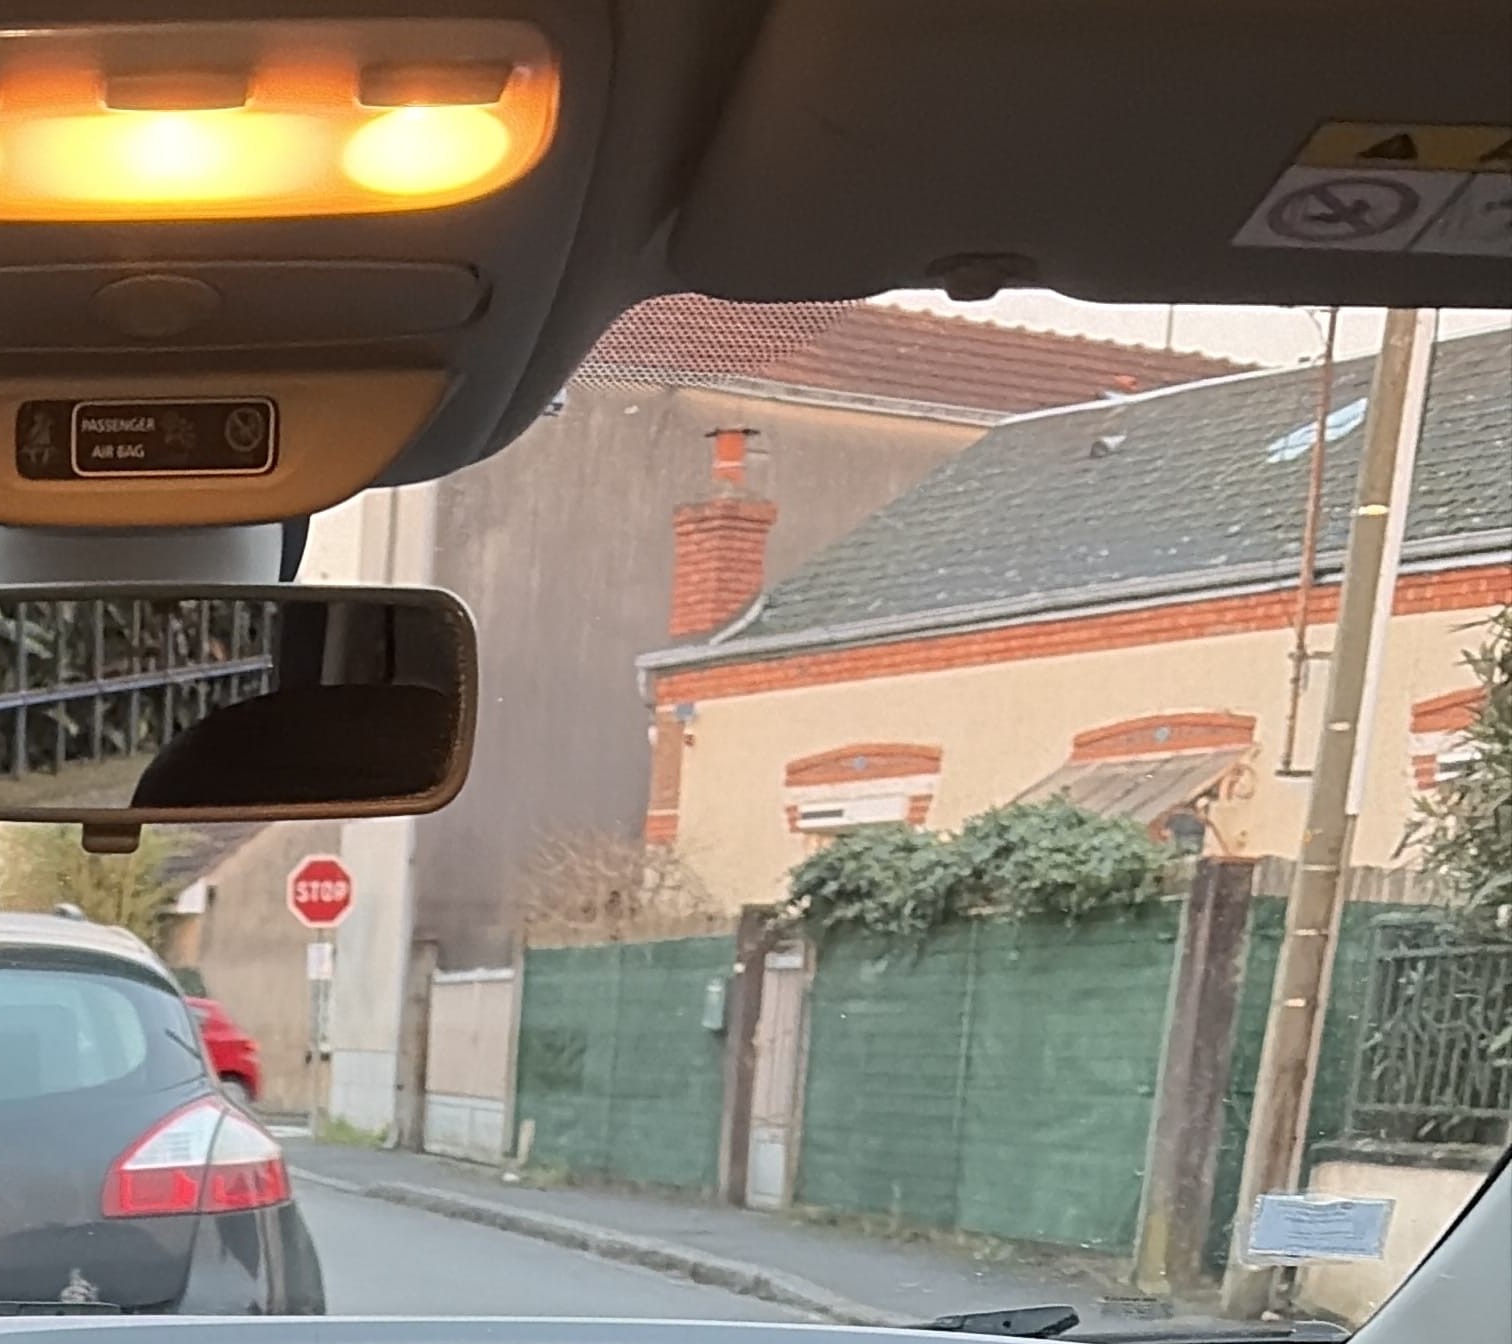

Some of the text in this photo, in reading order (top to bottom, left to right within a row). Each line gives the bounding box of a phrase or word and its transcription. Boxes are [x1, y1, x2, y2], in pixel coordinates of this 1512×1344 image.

[81, 416, 155, 433] PASSENGER
[91, 444, 145, 459] AIR BAG
[296, 880, 347, 903] STOP
